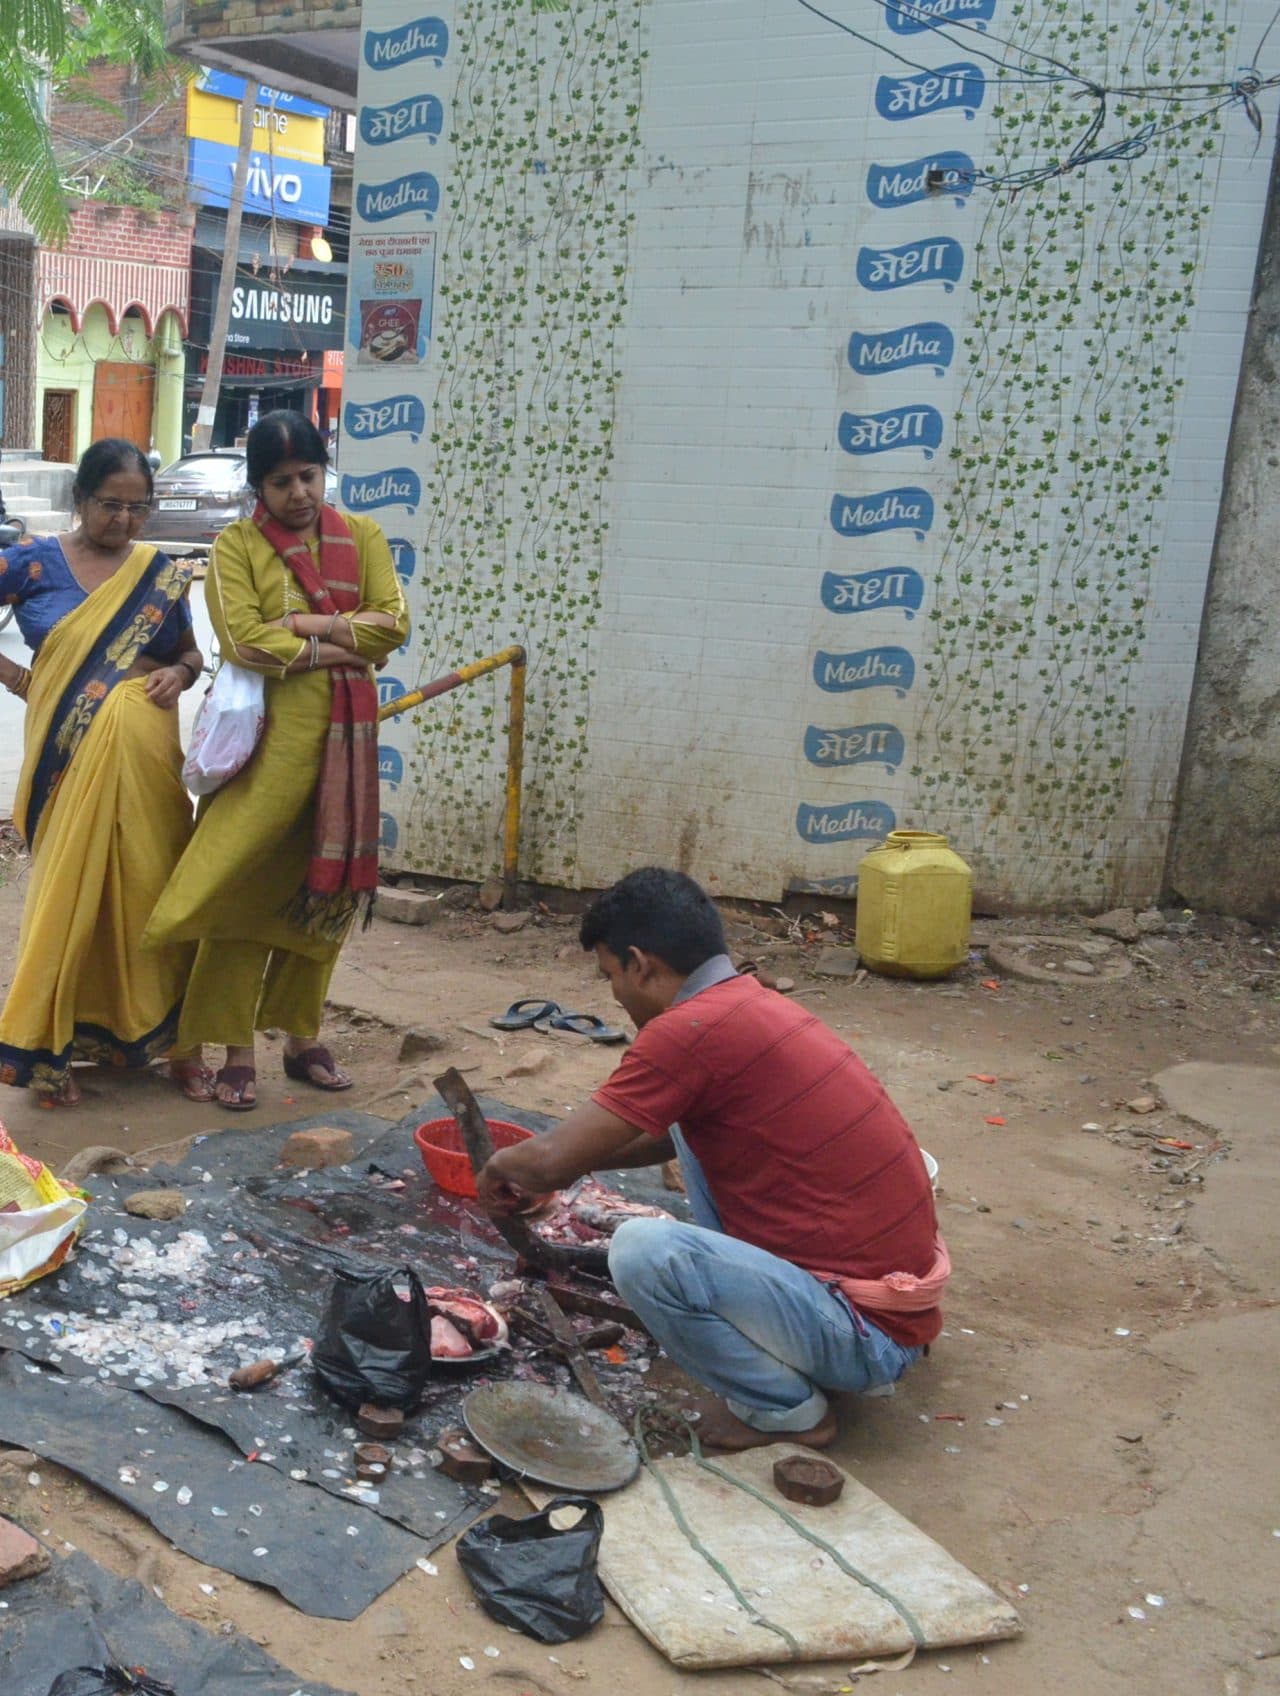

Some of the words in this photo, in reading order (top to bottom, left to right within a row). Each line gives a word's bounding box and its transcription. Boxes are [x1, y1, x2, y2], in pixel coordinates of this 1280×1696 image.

[373, 27, 438, 62] Medha
[887, 70, 972, 114] मेधा
[237, 105, 288, 134] ralme
[369, 99, 432, 139] मेधा
[365, 181, 429, 214] Medha
[868, 244, 950, 284] मेधा
[231, 286, 332, 325] SAMSUNG
[858, 332, 941, 367] Medha
[353, 400, 415, 436] मेधा
[850, 412, 929, 447] मेधा
[349, 476, 412, 504] Medha
[841, 496, 921, 525] Medha
[832, 572, 911, 608] मेधा
[824, 654, 903, 684] Medha
[815, 728, 891, 761] मेधा
[807, 808, 884, 835] Medha
